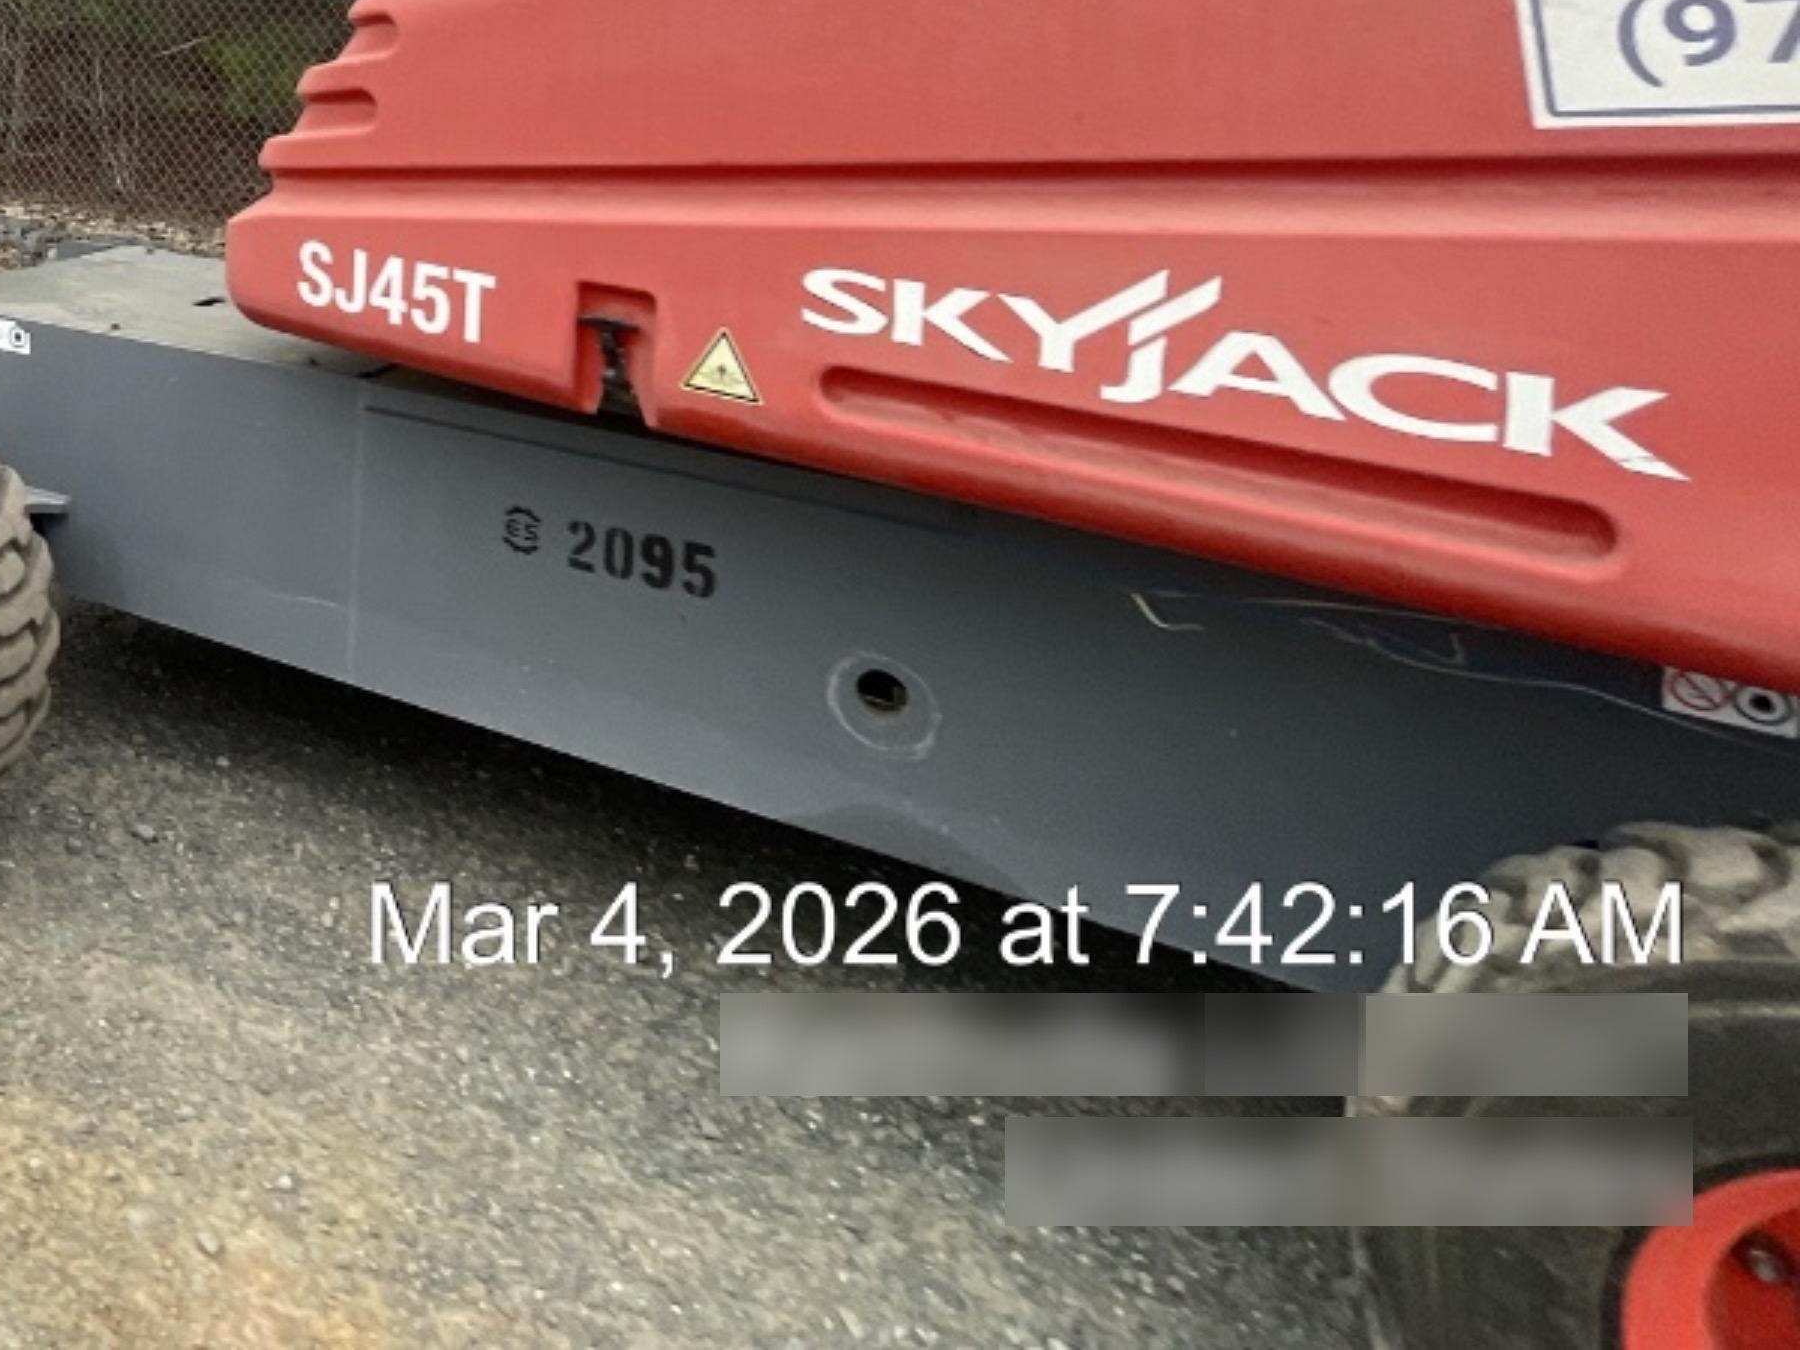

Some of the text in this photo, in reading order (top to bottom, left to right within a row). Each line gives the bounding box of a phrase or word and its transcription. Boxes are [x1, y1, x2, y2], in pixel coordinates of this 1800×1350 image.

[297, 239, 497, 343] SJ45T
[802, 268, 1691, 482] SKYJACK
[566, 518, 717, 599] 2095
